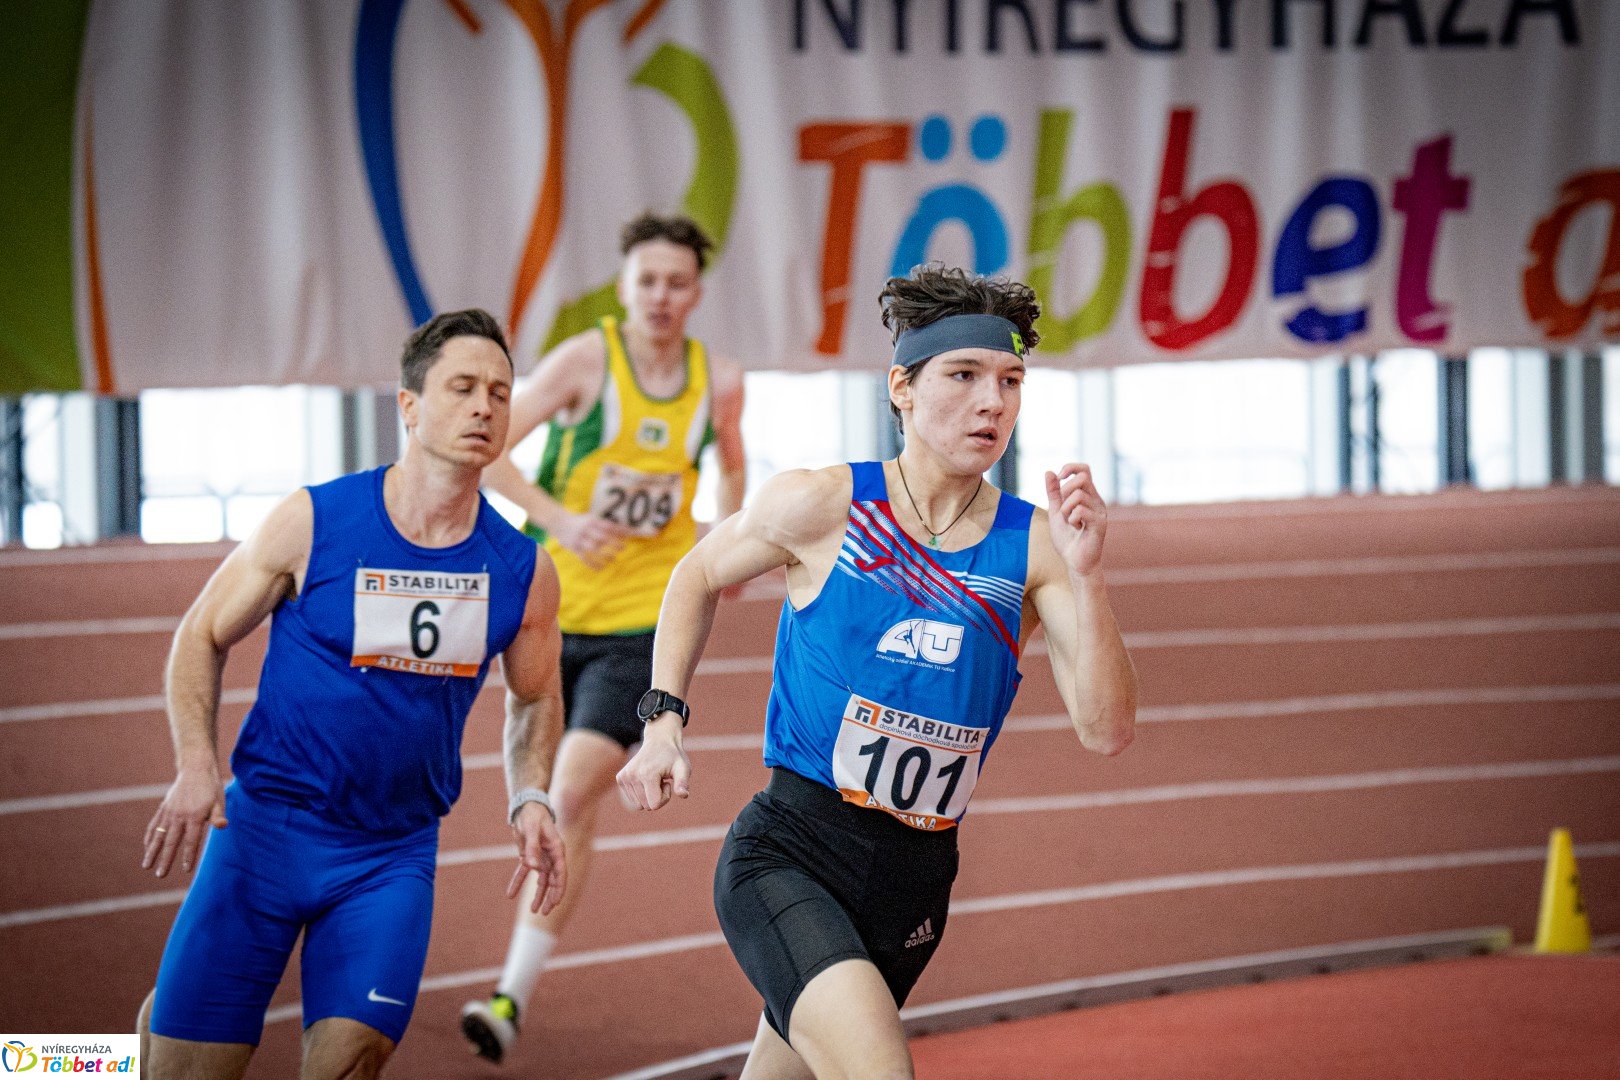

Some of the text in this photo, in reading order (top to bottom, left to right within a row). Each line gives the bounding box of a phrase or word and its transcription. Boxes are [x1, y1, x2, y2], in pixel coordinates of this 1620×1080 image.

[797, 106, 1471, 355] Többet
[602, 486, 673, 528] 209
[389, 574, 479, 591] STABILITA
[410, 600, 441, 659] 6
[377, 656, 455, 676] ATLETIKA
[881, 709, 980, 744] STABILITA
[858, 735, 968, 816] 101
[904, 934, 935, 949] adidas
